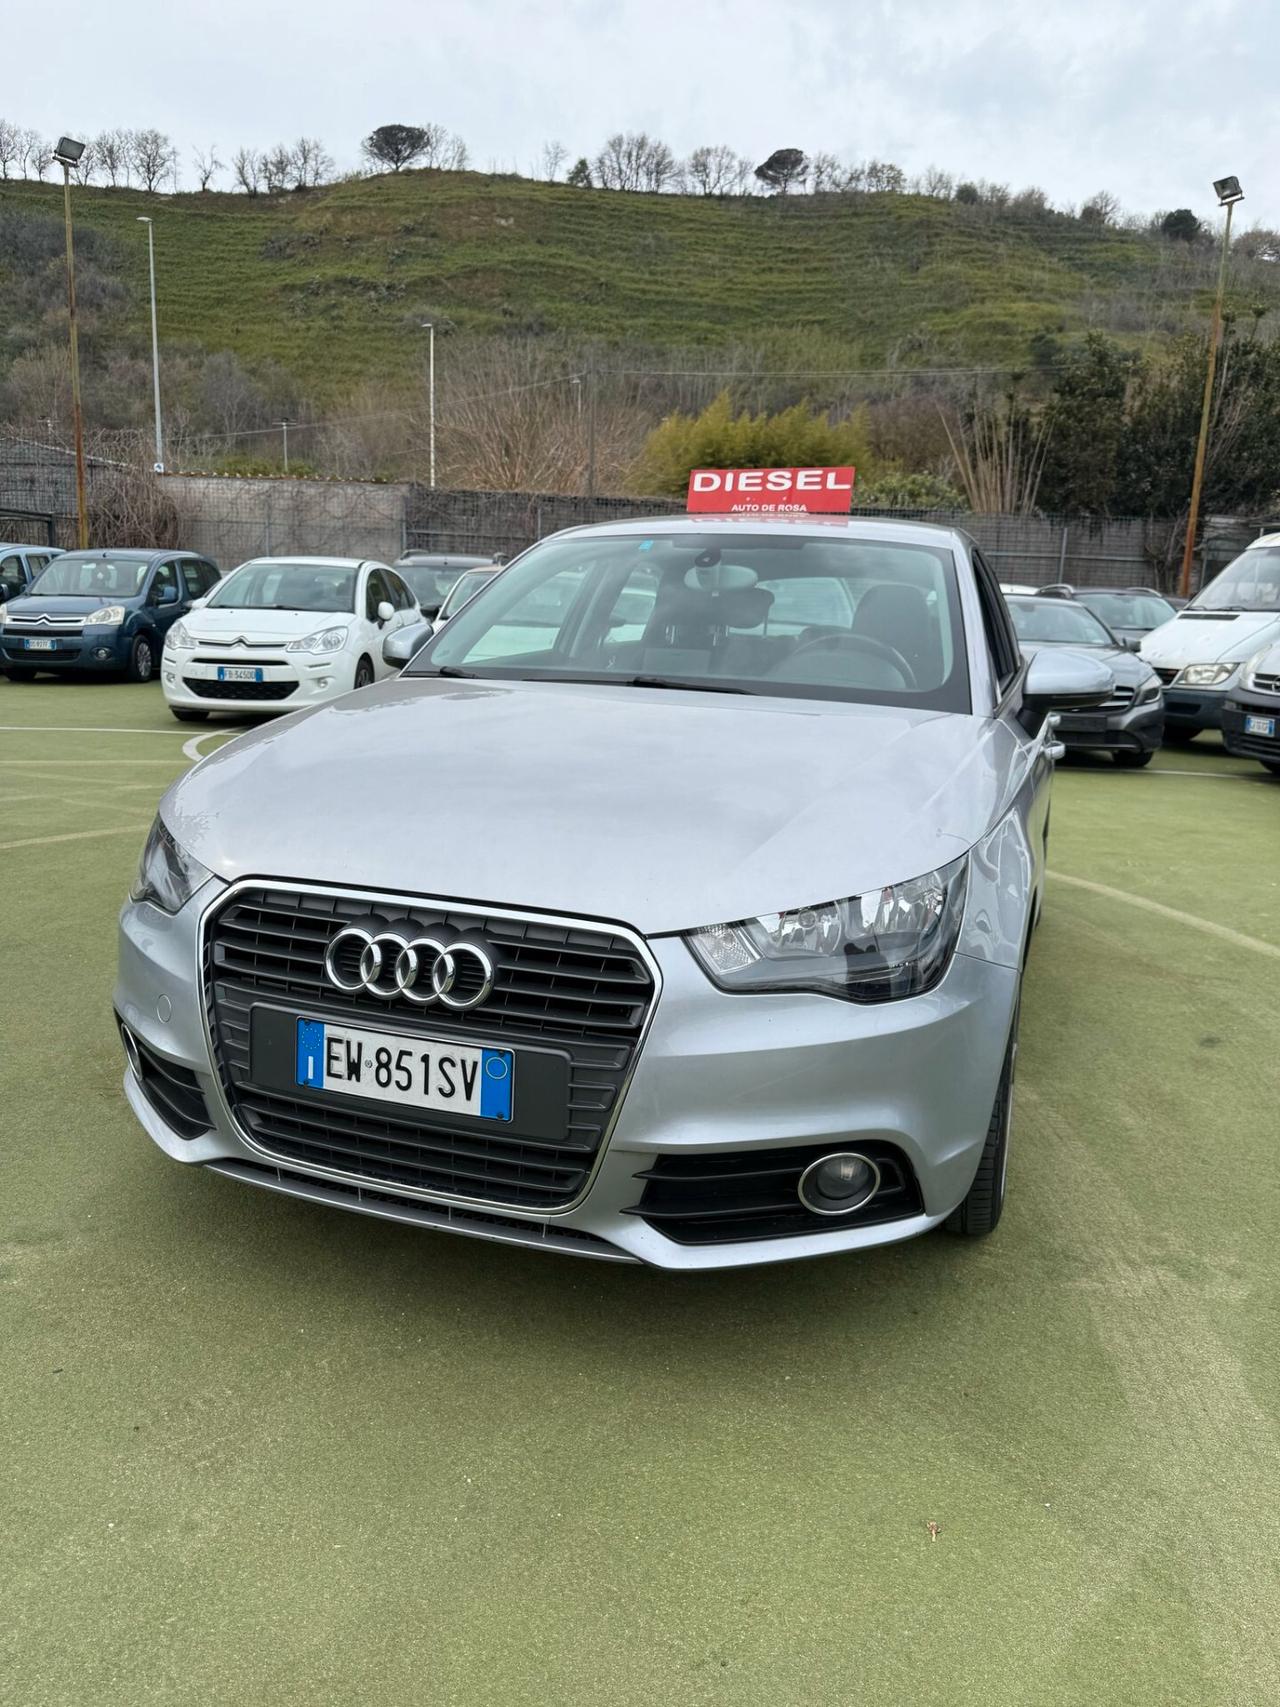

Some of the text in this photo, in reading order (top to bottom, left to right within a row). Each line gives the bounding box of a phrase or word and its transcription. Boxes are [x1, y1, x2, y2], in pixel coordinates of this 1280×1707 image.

[693, 470, 851, 492] DIESEL
[731, 504, 807, 512] AUTO DE ROSA
